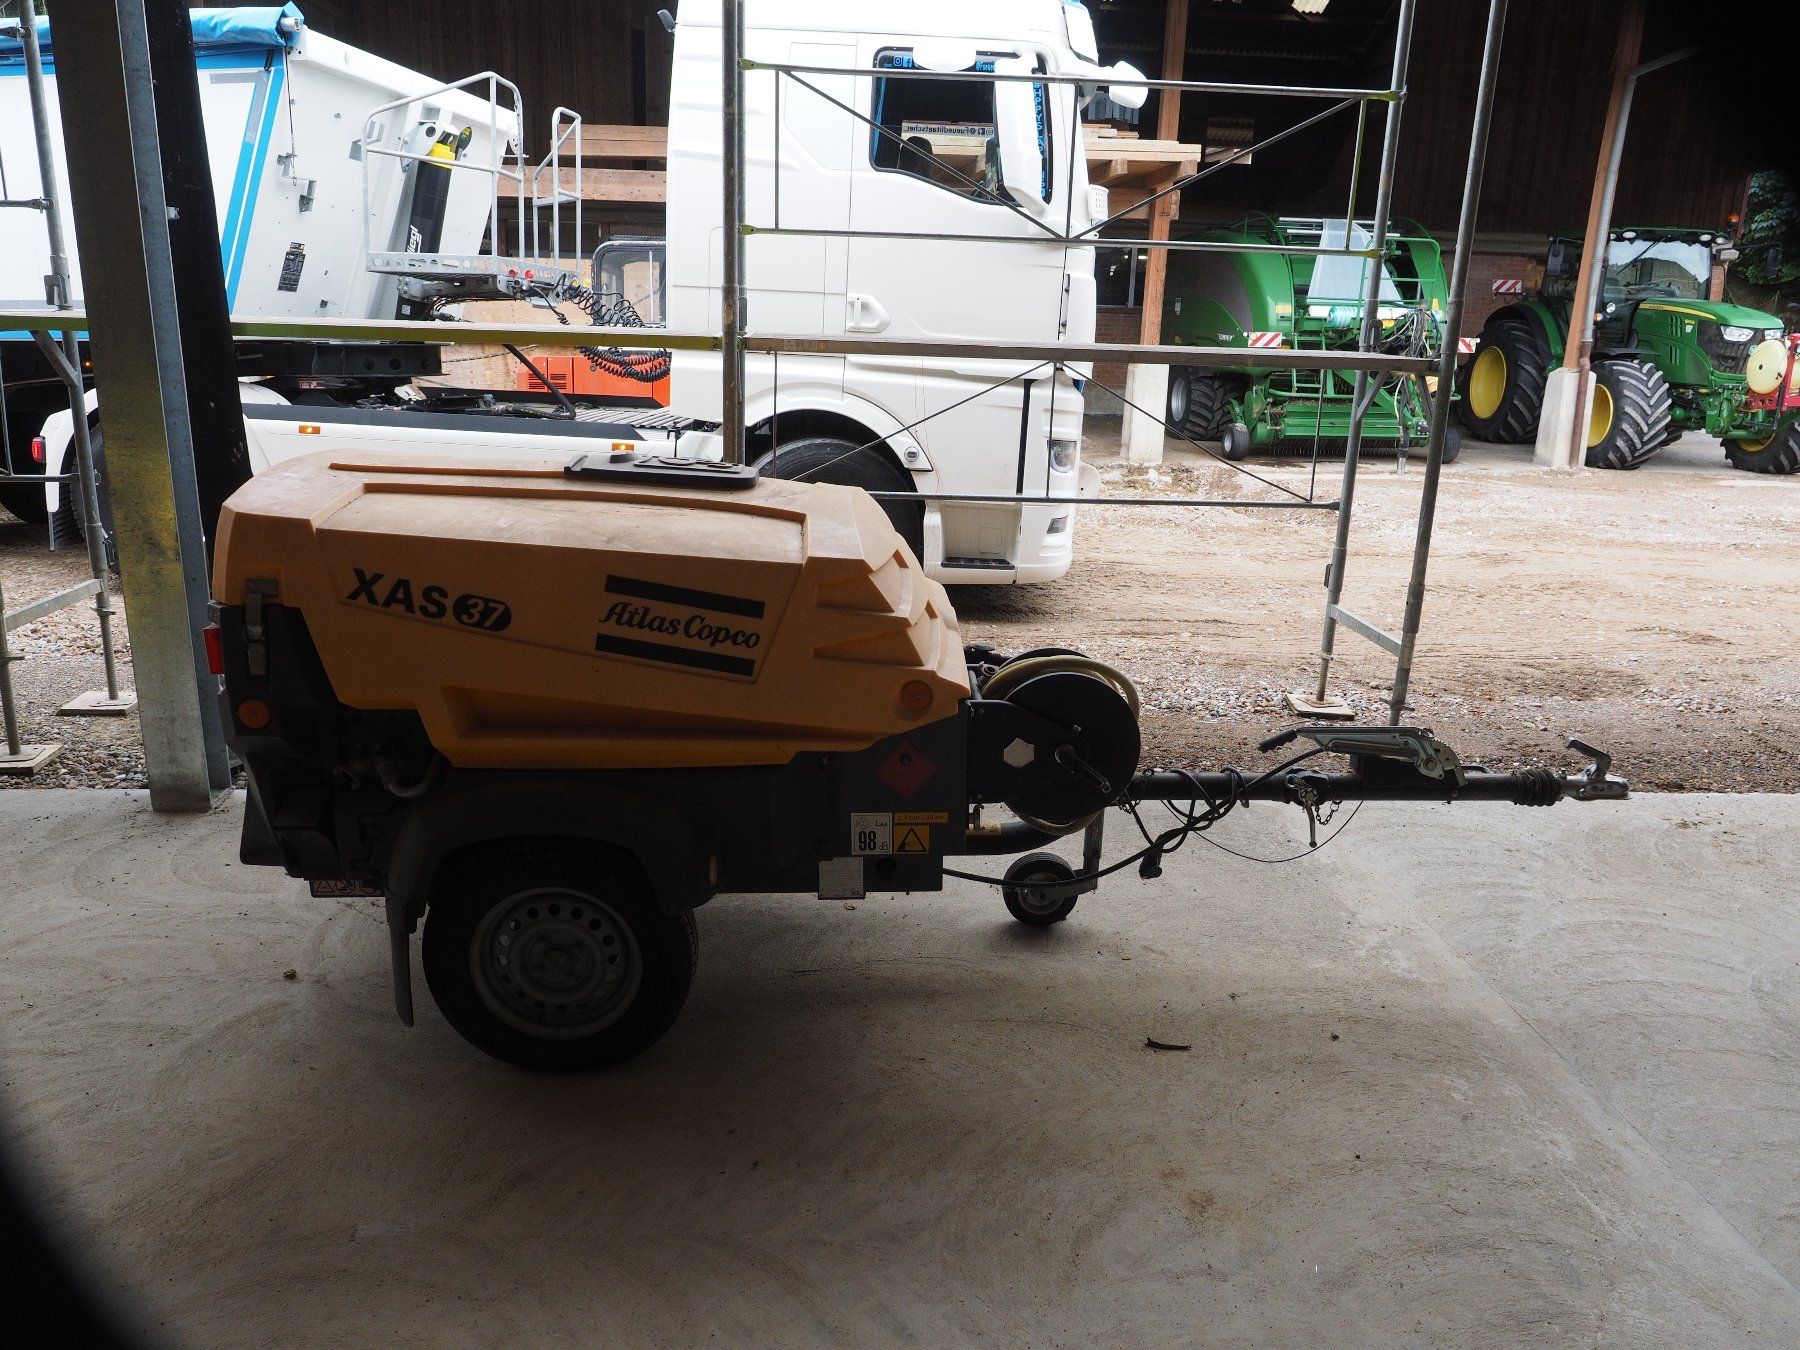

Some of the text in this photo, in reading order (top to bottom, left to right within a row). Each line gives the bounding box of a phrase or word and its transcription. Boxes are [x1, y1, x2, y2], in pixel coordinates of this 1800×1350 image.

[346, 567, 506, 628] XAS 37
[598, 601, 761, 649] Atlas Copco
[858, 830, 877, 851] 98
